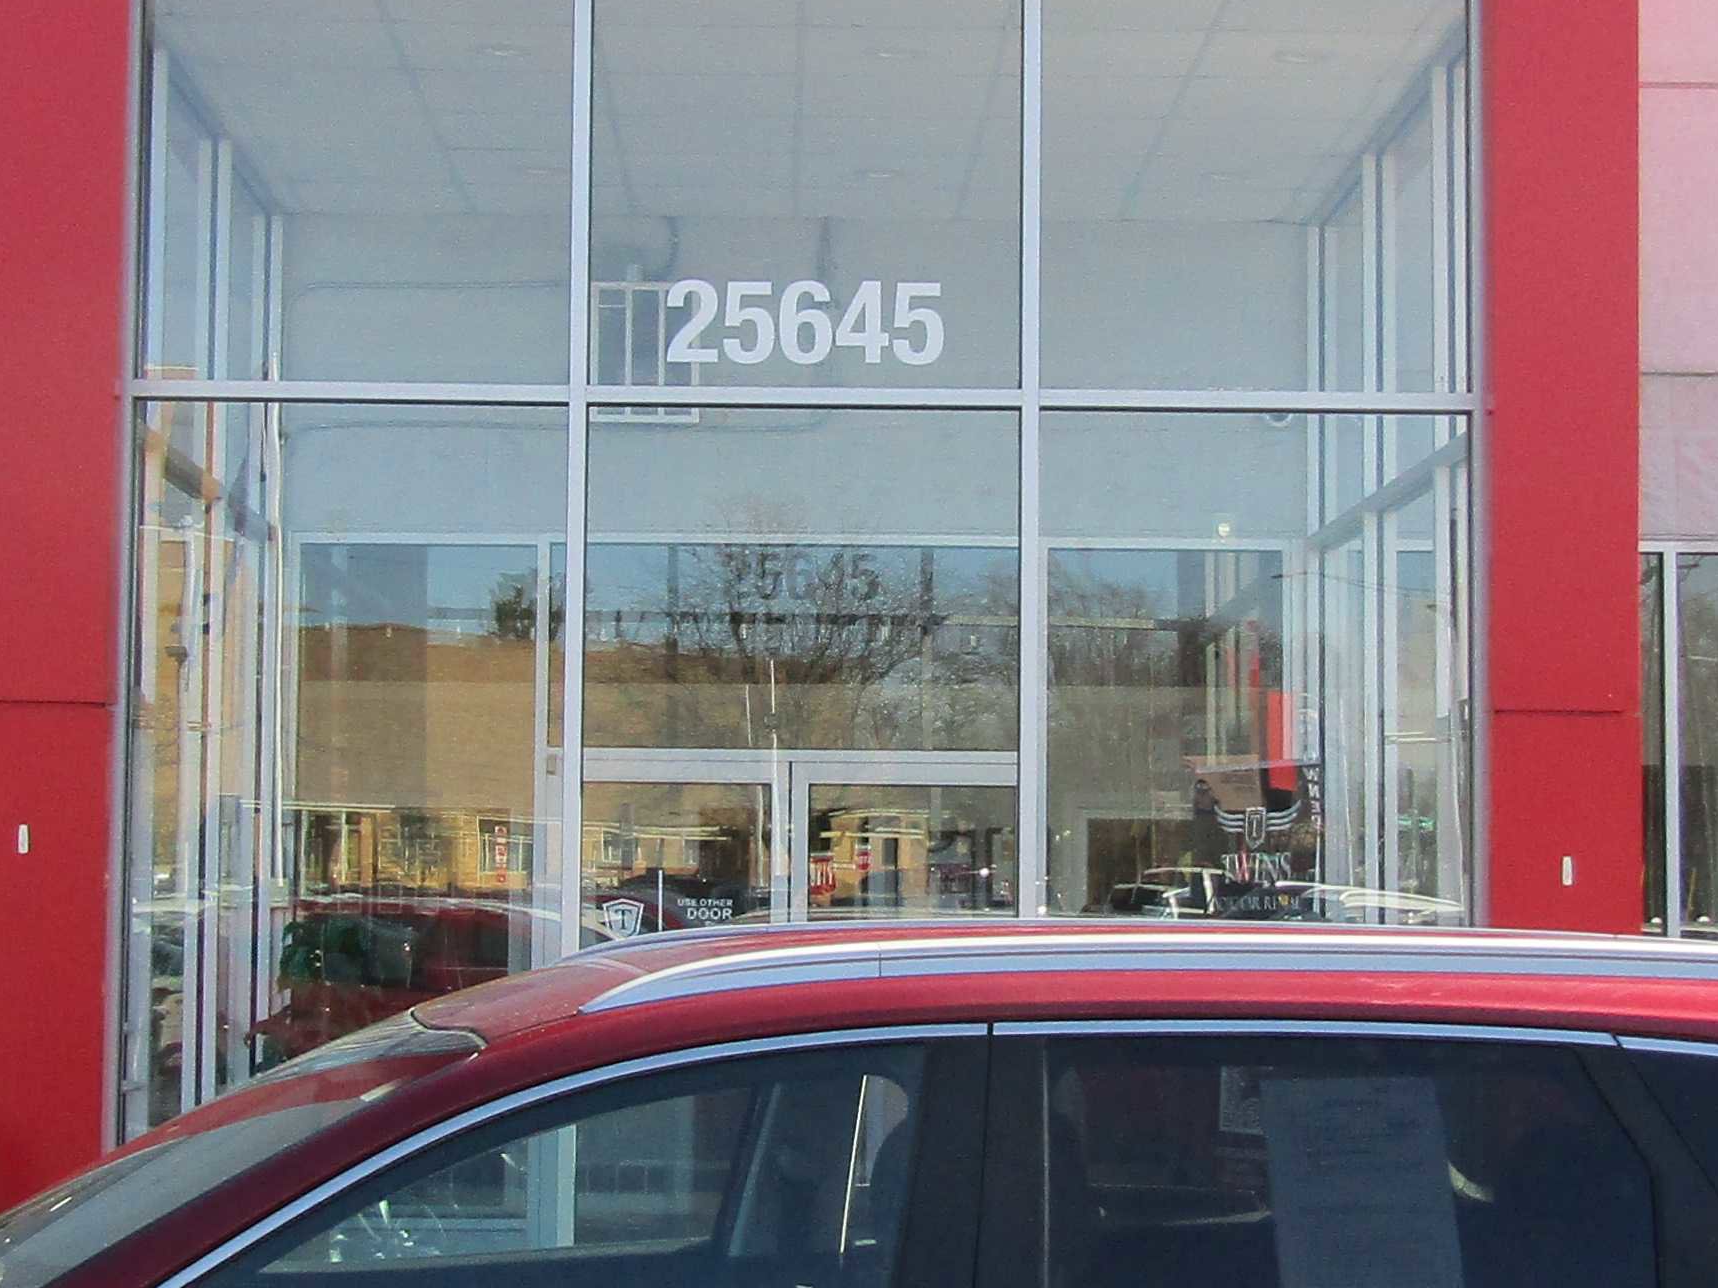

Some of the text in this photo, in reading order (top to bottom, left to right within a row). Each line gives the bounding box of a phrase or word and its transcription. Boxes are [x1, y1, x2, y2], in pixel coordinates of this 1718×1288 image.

[666, 279, 944, 365] 25645
[699, 898, 733, 907] OTHER
[686, 907, 733, 920] DOOR
